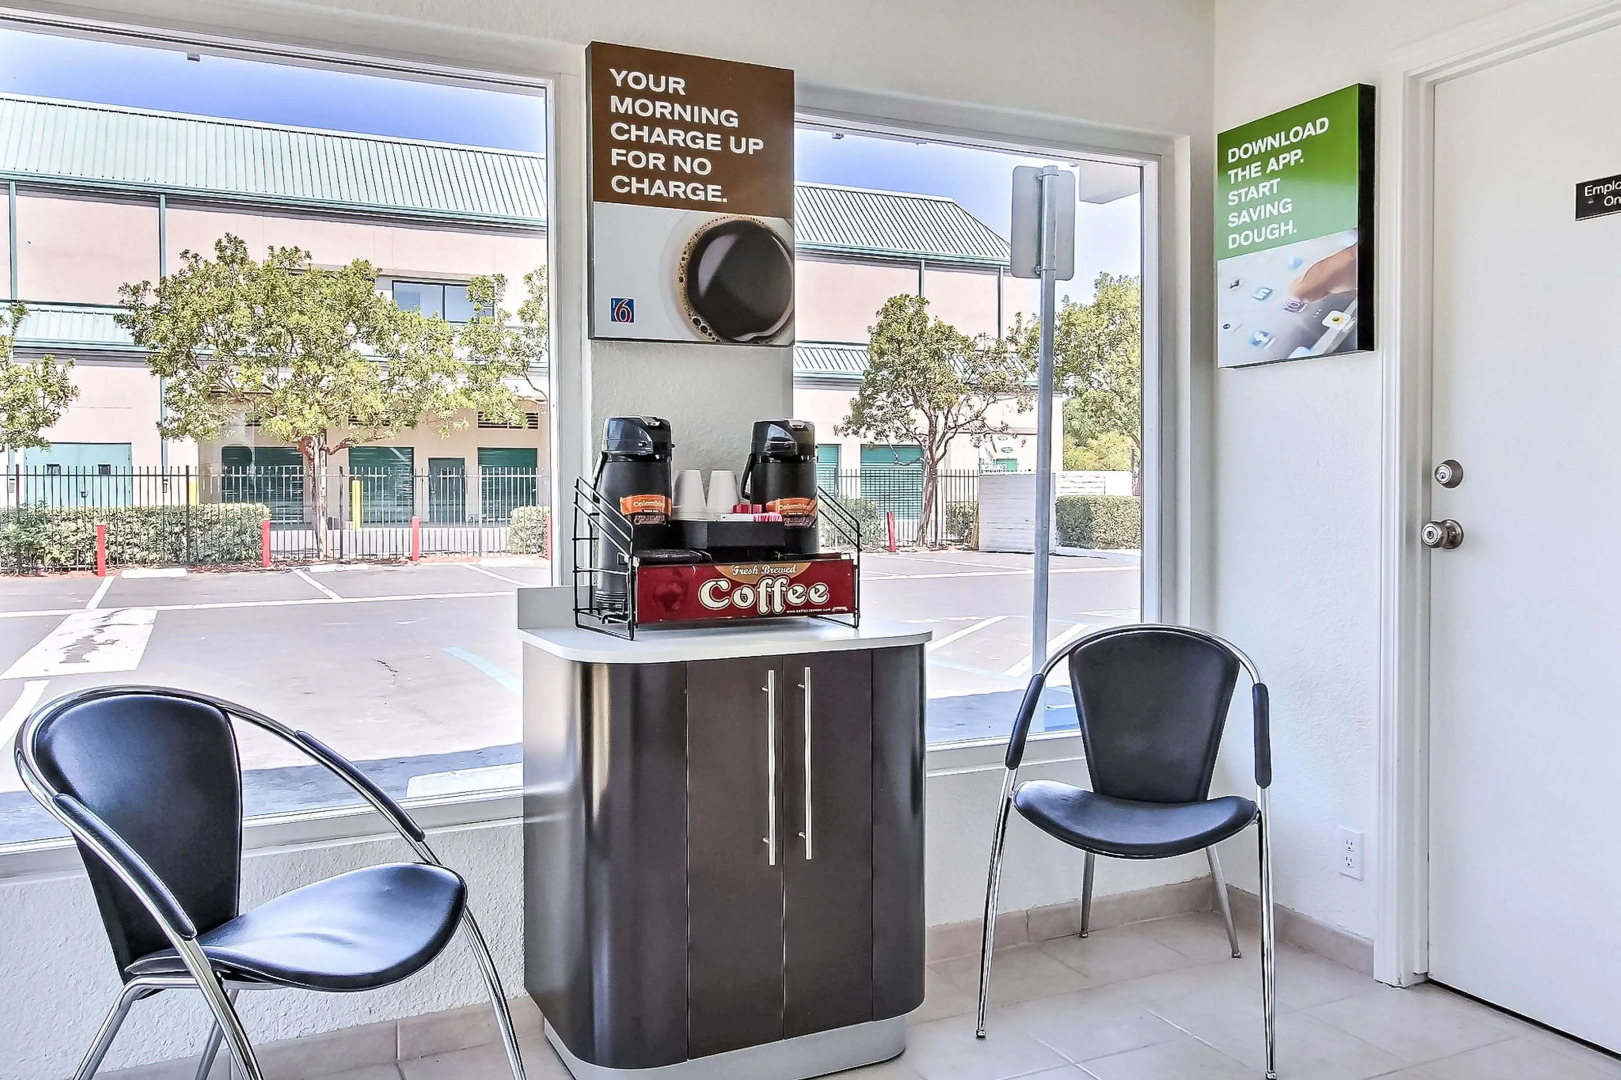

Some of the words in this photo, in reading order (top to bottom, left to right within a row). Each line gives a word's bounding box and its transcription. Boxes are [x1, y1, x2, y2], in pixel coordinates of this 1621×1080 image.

[609, 68, 687, 96] YOUR
[610, 95, 739, 128] MORNING
[610, 122, 722, 151] CHARGE
[729, 135, 764, 155] UP
[1227, 116, 1330, 164] DOWNLOAD
[611, 148, 666, 171] FOR
[673, 155, 712, 176] NO
[1227, 161, 1262, 185] THE
[1266, 149, 1305, 174] APP.
[611, 175, 728, 203] CHARGE.
[1227, 178, 1281, 206] START
[1227, 197, 1293, 228] SAVING
[1228, 219, 1298, 250] DOUGH.
[732, 564, 758, 576] Fresh
[760, 563, 797, 575] Brewed
[698, 575, 830, 615] Coffee
